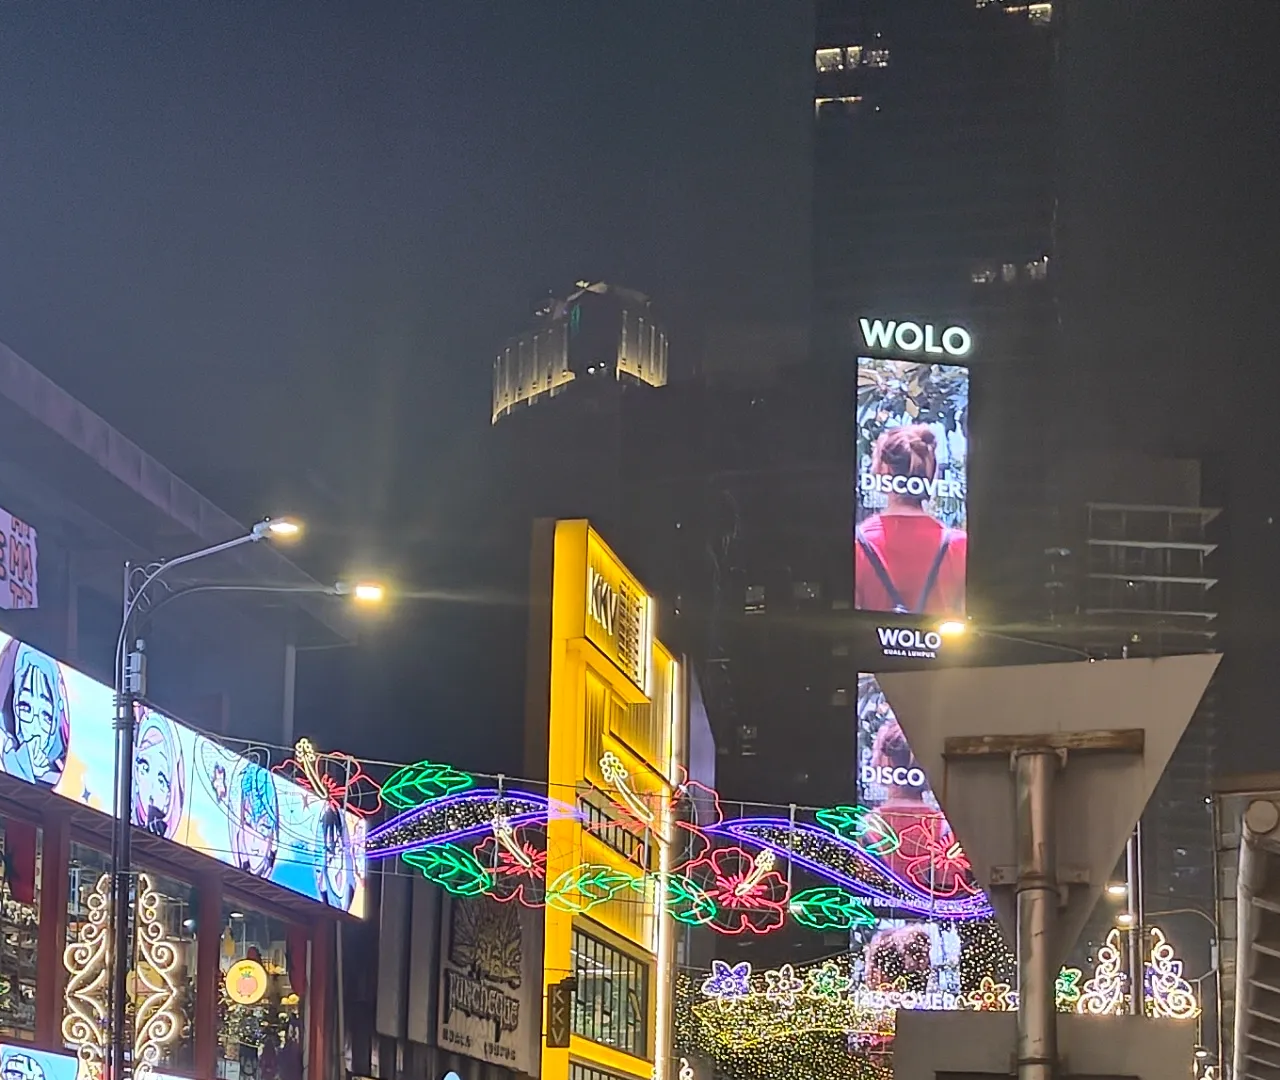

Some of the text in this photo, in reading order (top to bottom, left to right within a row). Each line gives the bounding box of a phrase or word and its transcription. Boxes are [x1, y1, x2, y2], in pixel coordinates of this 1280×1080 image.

[858, 317, 972, 356] WOLO
[860, 471, 964, 500] DISCOVER
[587, 565, 618, 637] KKV
[877, 627, 942, 650] WOLO
[883, 648, 936, 659] KUALA LUMPUR
[551, 988, 565, 1046] KKV
